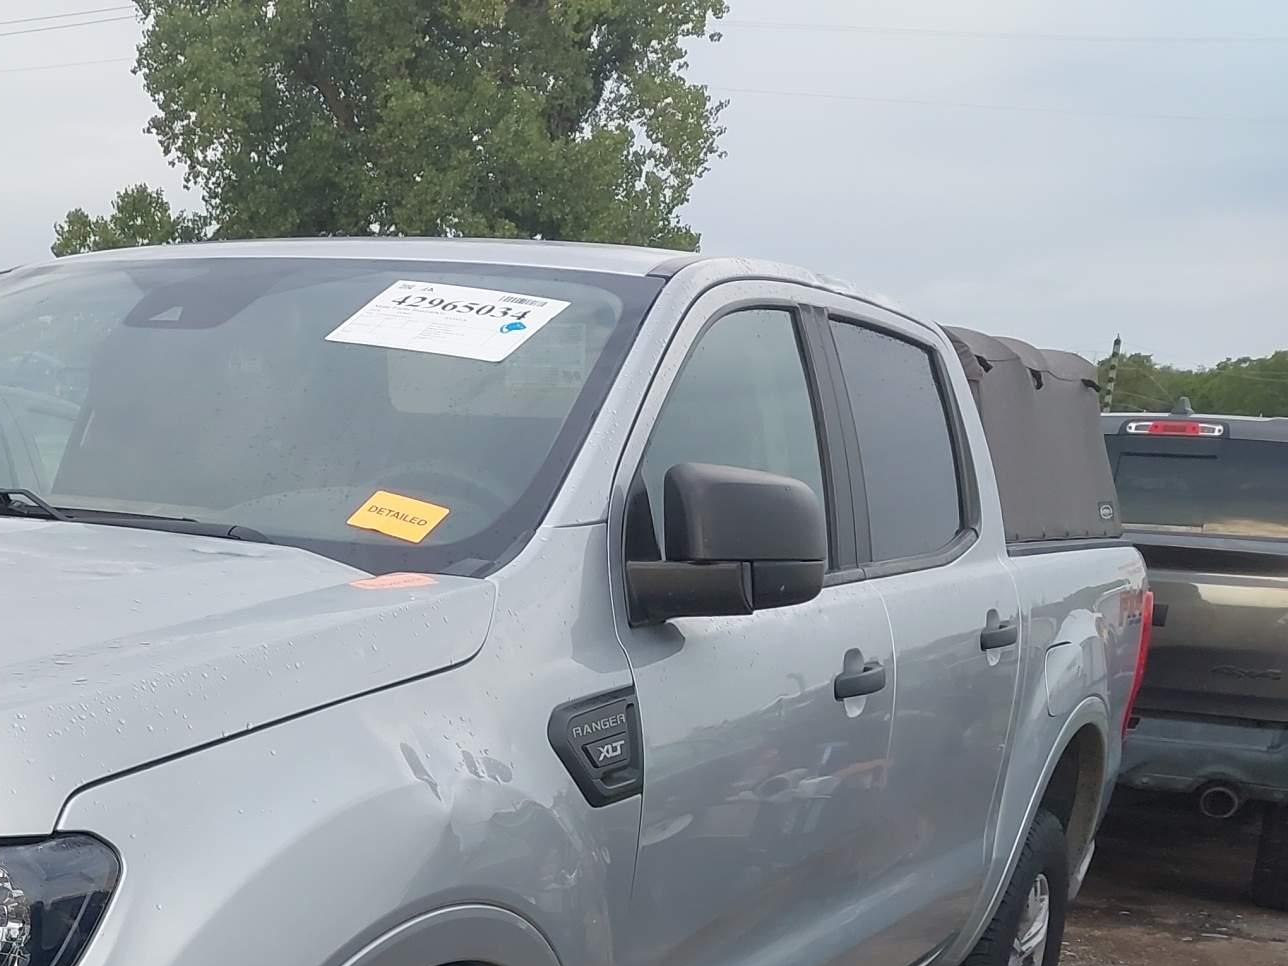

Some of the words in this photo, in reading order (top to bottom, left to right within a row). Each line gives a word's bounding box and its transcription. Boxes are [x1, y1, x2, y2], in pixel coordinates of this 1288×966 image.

[392, 294, 532, 321] 42965034
[367, 505, 428, 527] DETAILED
[572, 713, 626, 738] RANGER
[598, 740, 625, 761] XLT
